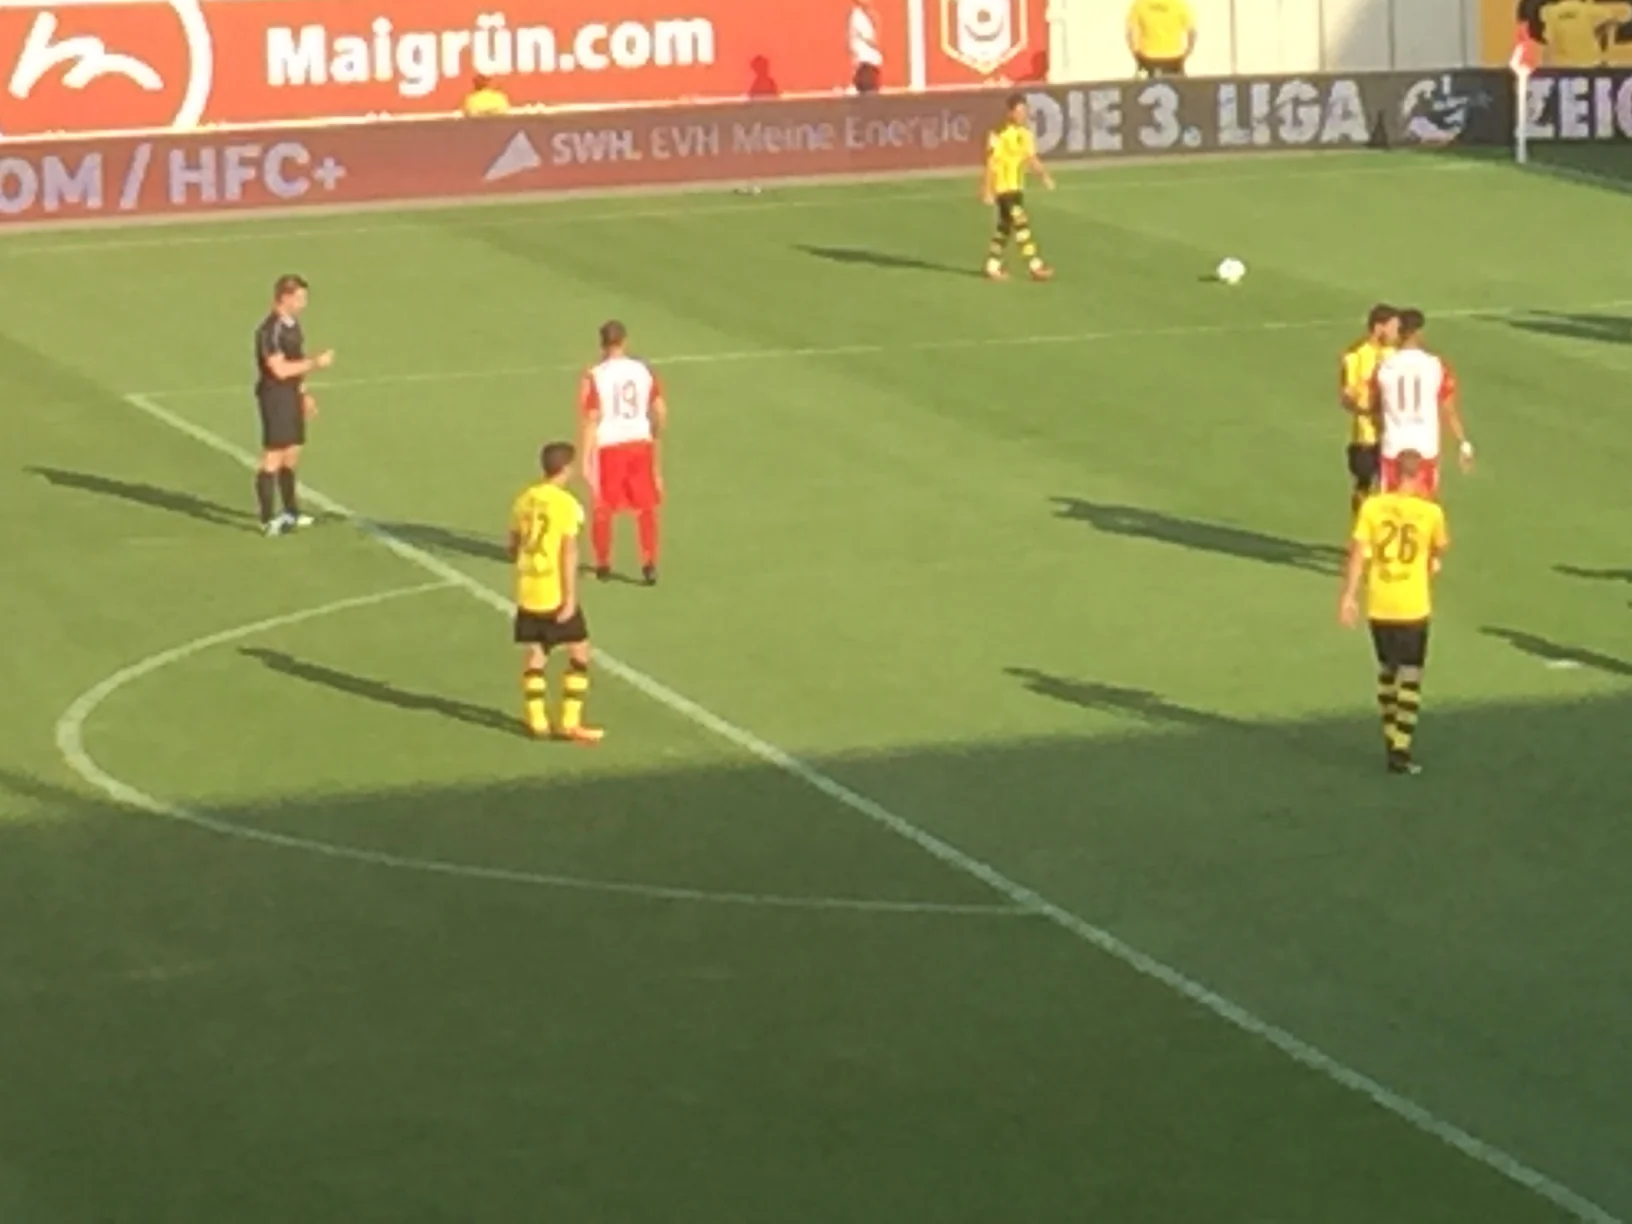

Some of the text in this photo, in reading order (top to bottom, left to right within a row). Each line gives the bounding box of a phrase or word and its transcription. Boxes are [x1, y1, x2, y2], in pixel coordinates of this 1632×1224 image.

[266, 12, 715, 96] Maigrün.com
[651, 123, 719, 160] EVH
[732, 120, 834, 153] Meine
[846, 110, 972, 151] Energie
[1026, 88, 1123, 154] DIE
[1138, 83, 1201, 148] 3.
[119, 142, 153, 210] /
[169, 142, 348, 205] HFC+
[612, 379, 640, 419] 19
[1397, 374, 1422, 413] 11
[1376, 520, 1420, 566] 26
